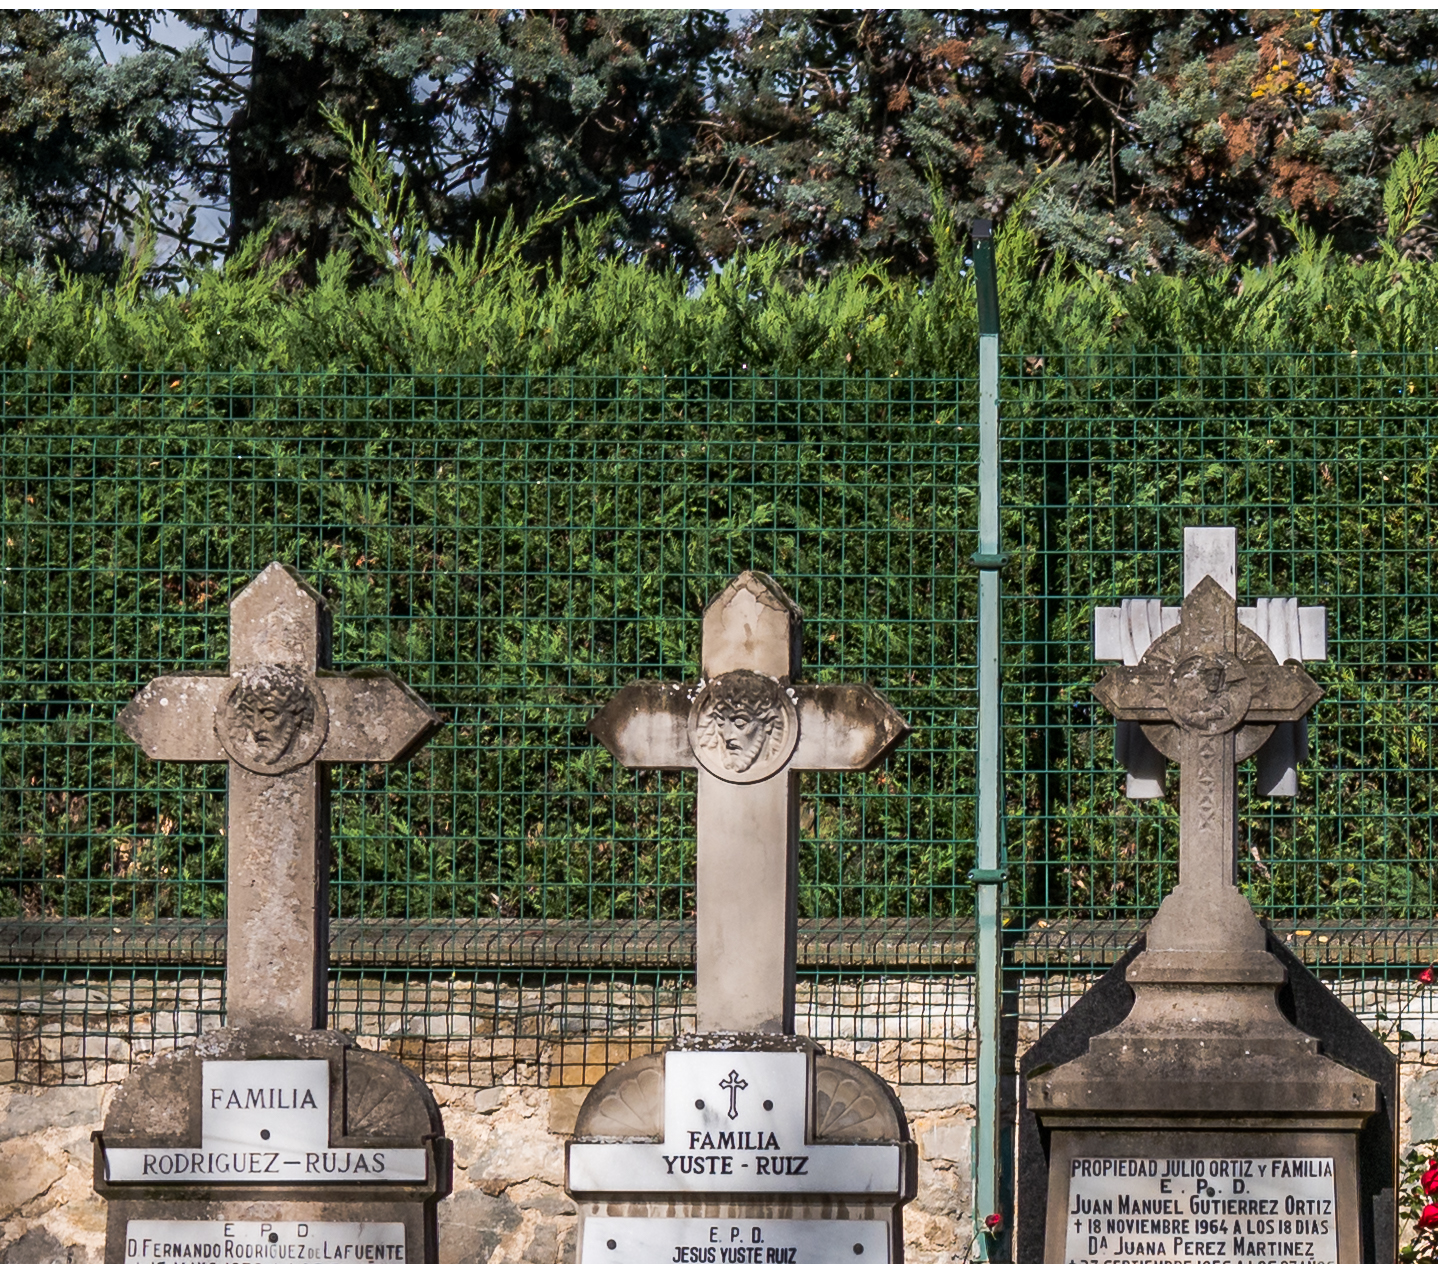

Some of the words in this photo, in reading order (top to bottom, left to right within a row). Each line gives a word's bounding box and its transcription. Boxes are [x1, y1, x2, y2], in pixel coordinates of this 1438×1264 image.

[211, 1088, 318, 1109] FAMILIA
[687, 1131, 780, 1150] FAMILIA
[662, 1156, 733, 1175] YUSTE
[756, 1156, 809, 1175] RUIZ
[1073, 1160, 1158, 1177] PROPIEDAD
[1162, 1160, 1205, 1178] JULIO
[1210, 1160, 1253, 1178] ORTIZ
[1272, 1160, 1332, 1178] FAMILIA
[672, 1247, 716, 1264] JESUS
[720, 1247, 763, 1264] YUSTE
[767, 1248, 797, 1264] RUIZ
